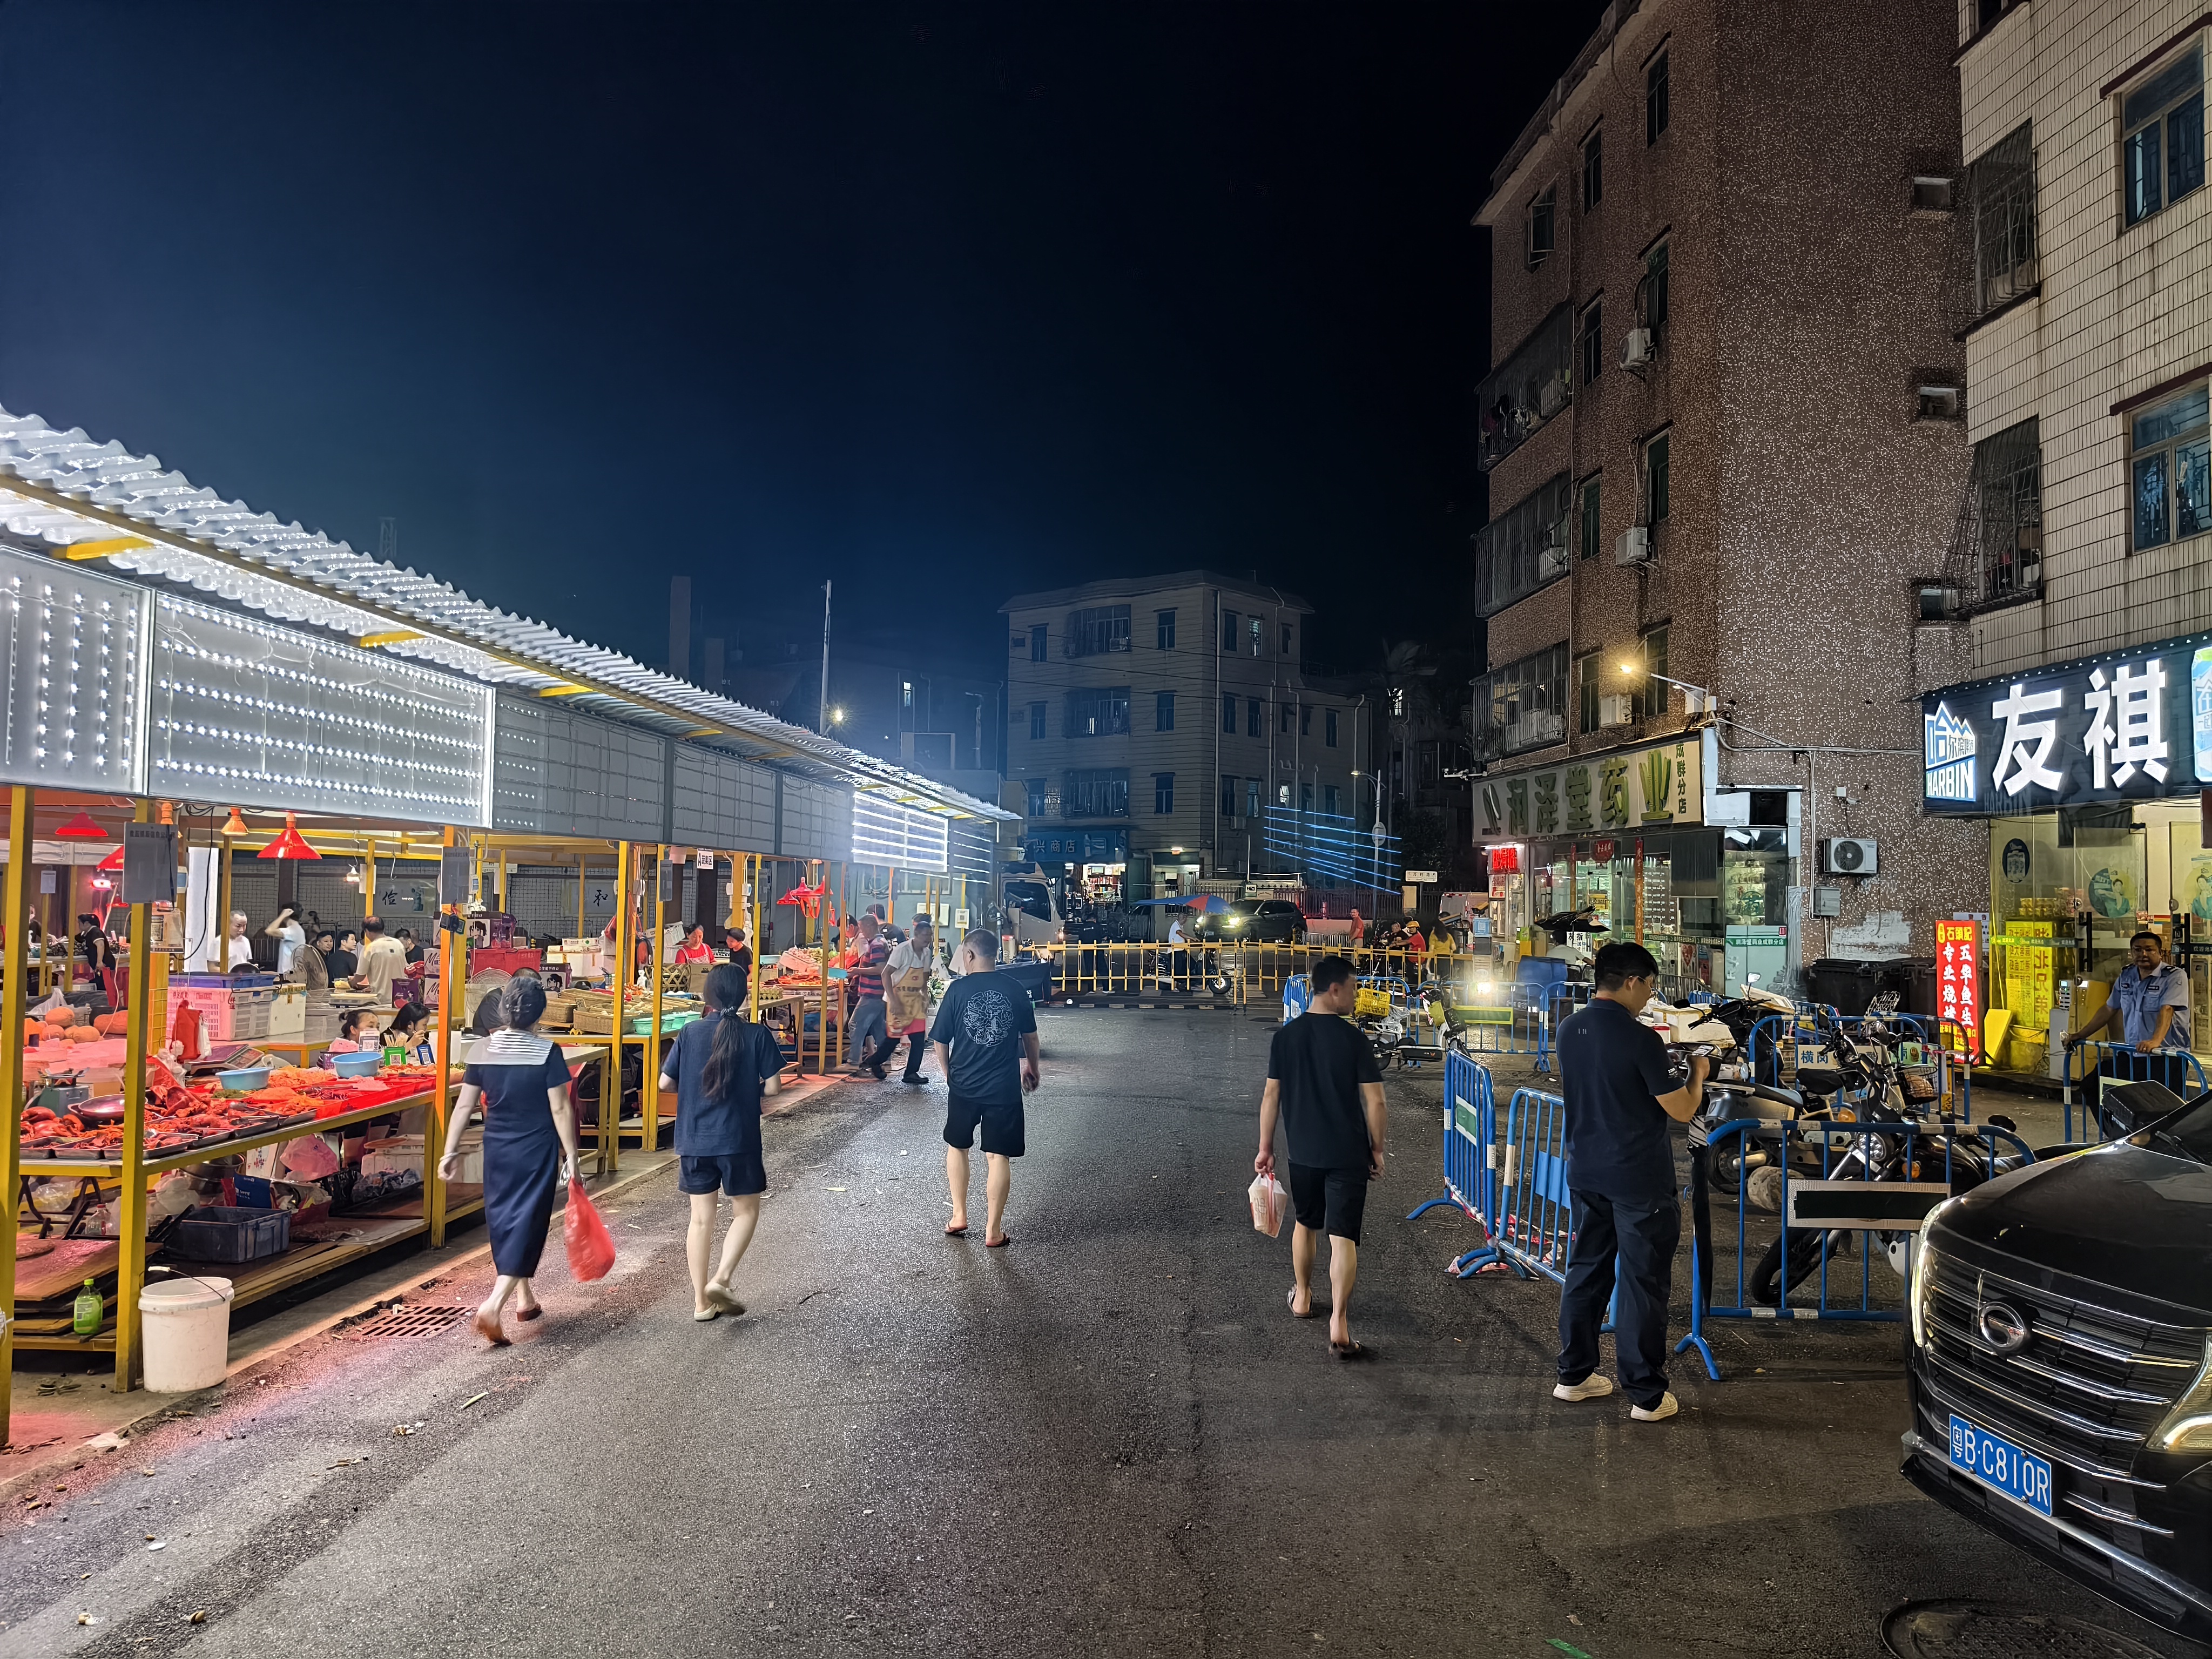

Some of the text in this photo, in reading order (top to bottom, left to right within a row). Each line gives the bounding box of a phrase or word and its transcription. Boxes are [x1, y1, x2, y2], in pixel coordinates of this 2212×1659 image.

[1992, 659, 2168, 797] 友祺
[1676, 743, 1687, 814] 成群分店
[1927, 759, 1974, 799] HARBIN
[1959, 943, 1974, 1027] 五华鱼生
